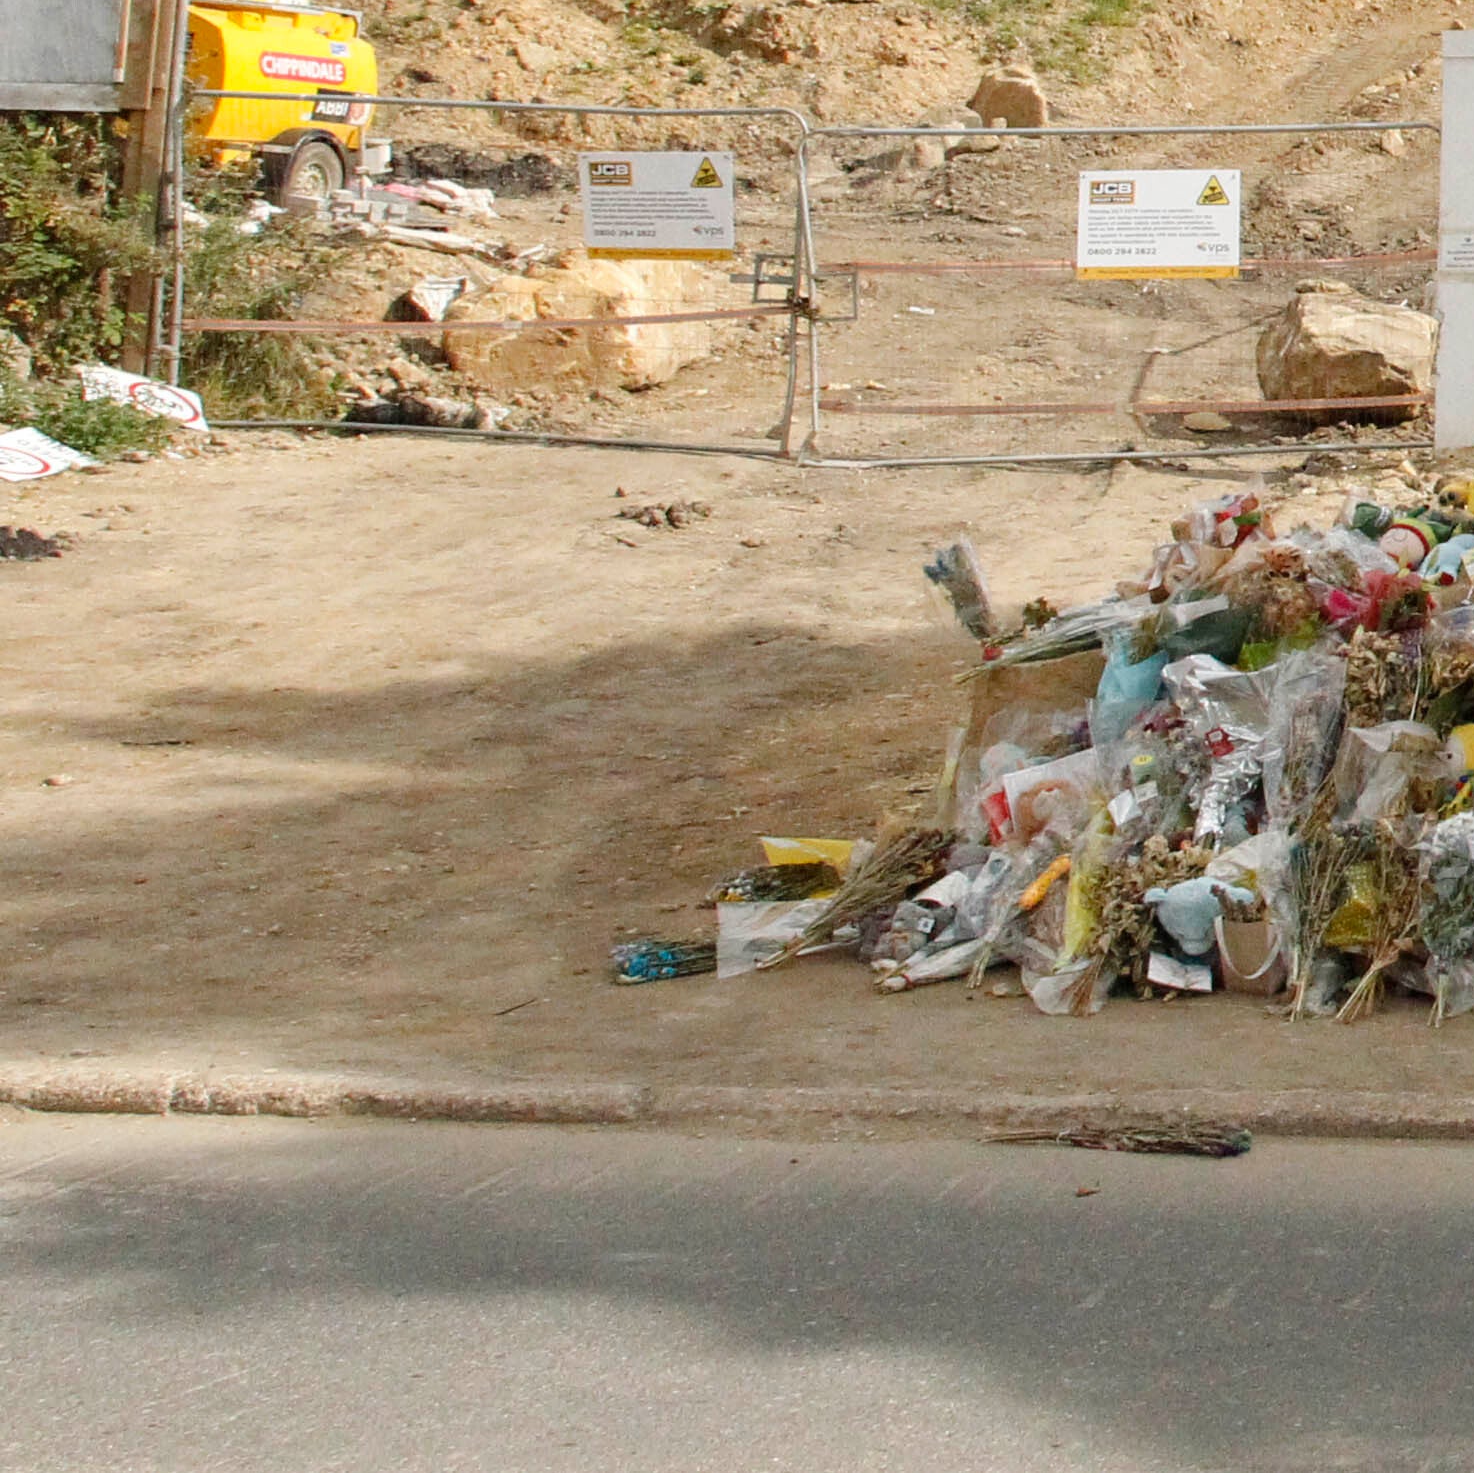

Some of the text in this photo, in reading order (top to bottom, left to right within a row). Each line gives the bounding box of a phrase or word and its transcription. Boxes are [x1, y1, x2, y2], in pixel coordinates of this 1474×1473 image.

[262, 55, 345, 82] CHIPPINDALE
[591, 164, 629, 176] JCB
[1092, 182, 1132, 194] JCB
[704, 227, 724, 236] vps
[1087, 247, 1112, 256] 0800
[1207, 242, 1230, 254] vps
